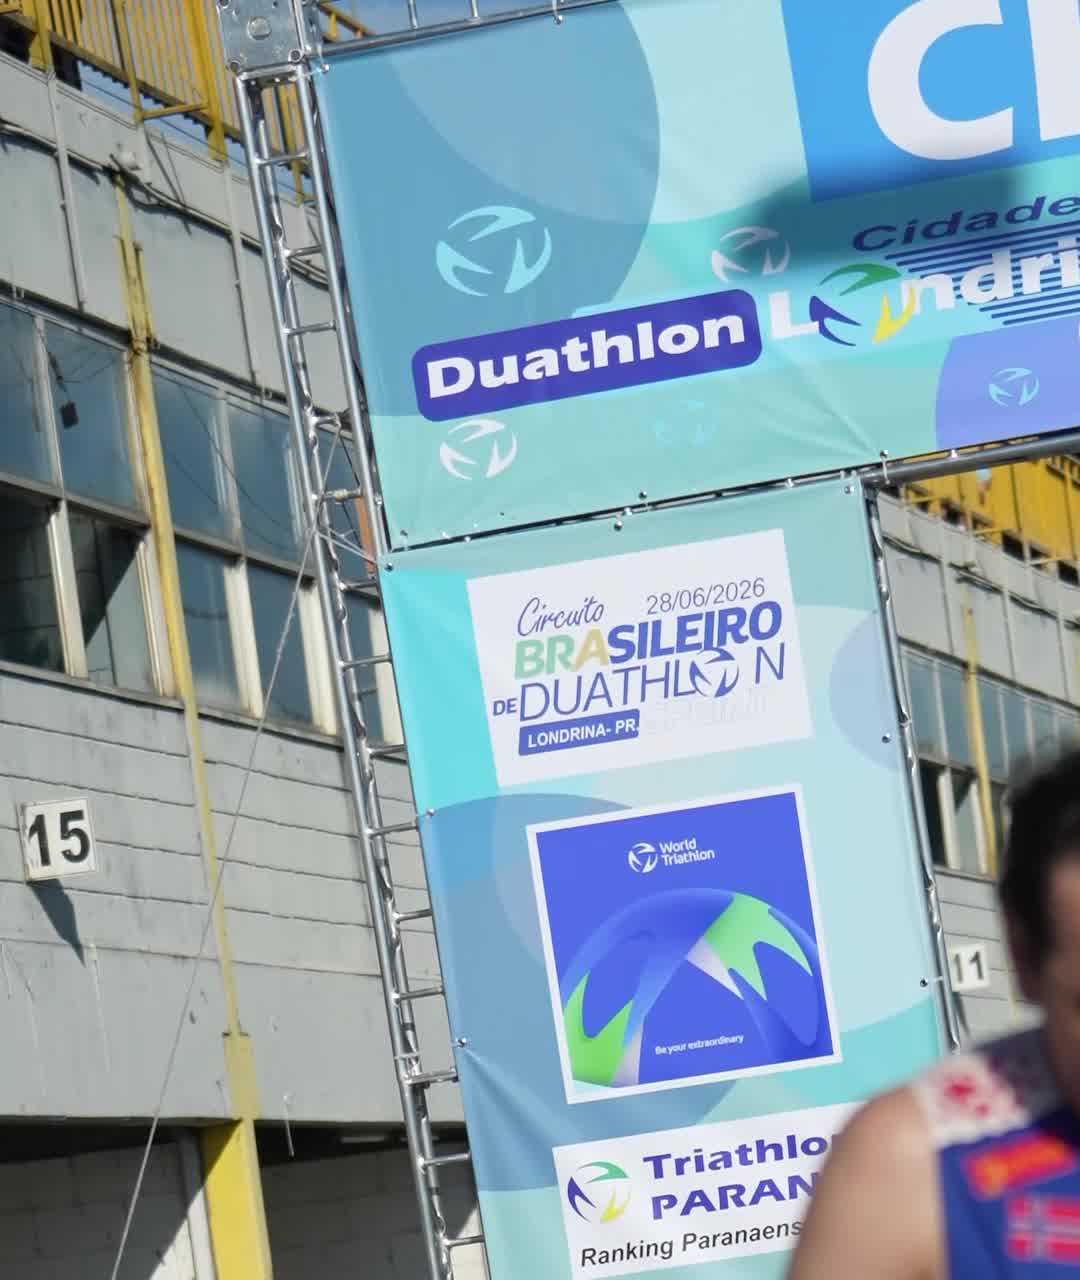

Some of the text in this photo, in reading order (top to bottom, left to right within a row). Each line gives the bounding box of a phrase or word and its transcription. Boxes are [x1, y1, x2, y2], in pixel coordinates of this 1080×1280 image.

[427, 309, 745, 399] Duathlon
[646, 577, 766, 615] 28/06/2026
[517, 596, 605, 637] Circuito
[514, 600, 783, 680] BRASILEIRO
[492, 697, 518, 717] DE
[28, 810, 90, 866] 15
[659, 838, 697, 854] World
[660, 848, 716, 867] Triathlon
[952, 951, 984, 983] 11
[655, 1034, 744, 1056] Be your extraordinary
[643, 1134, 834, 1179] Triathlo
[581, 1237, 674, 1267] Ranking
